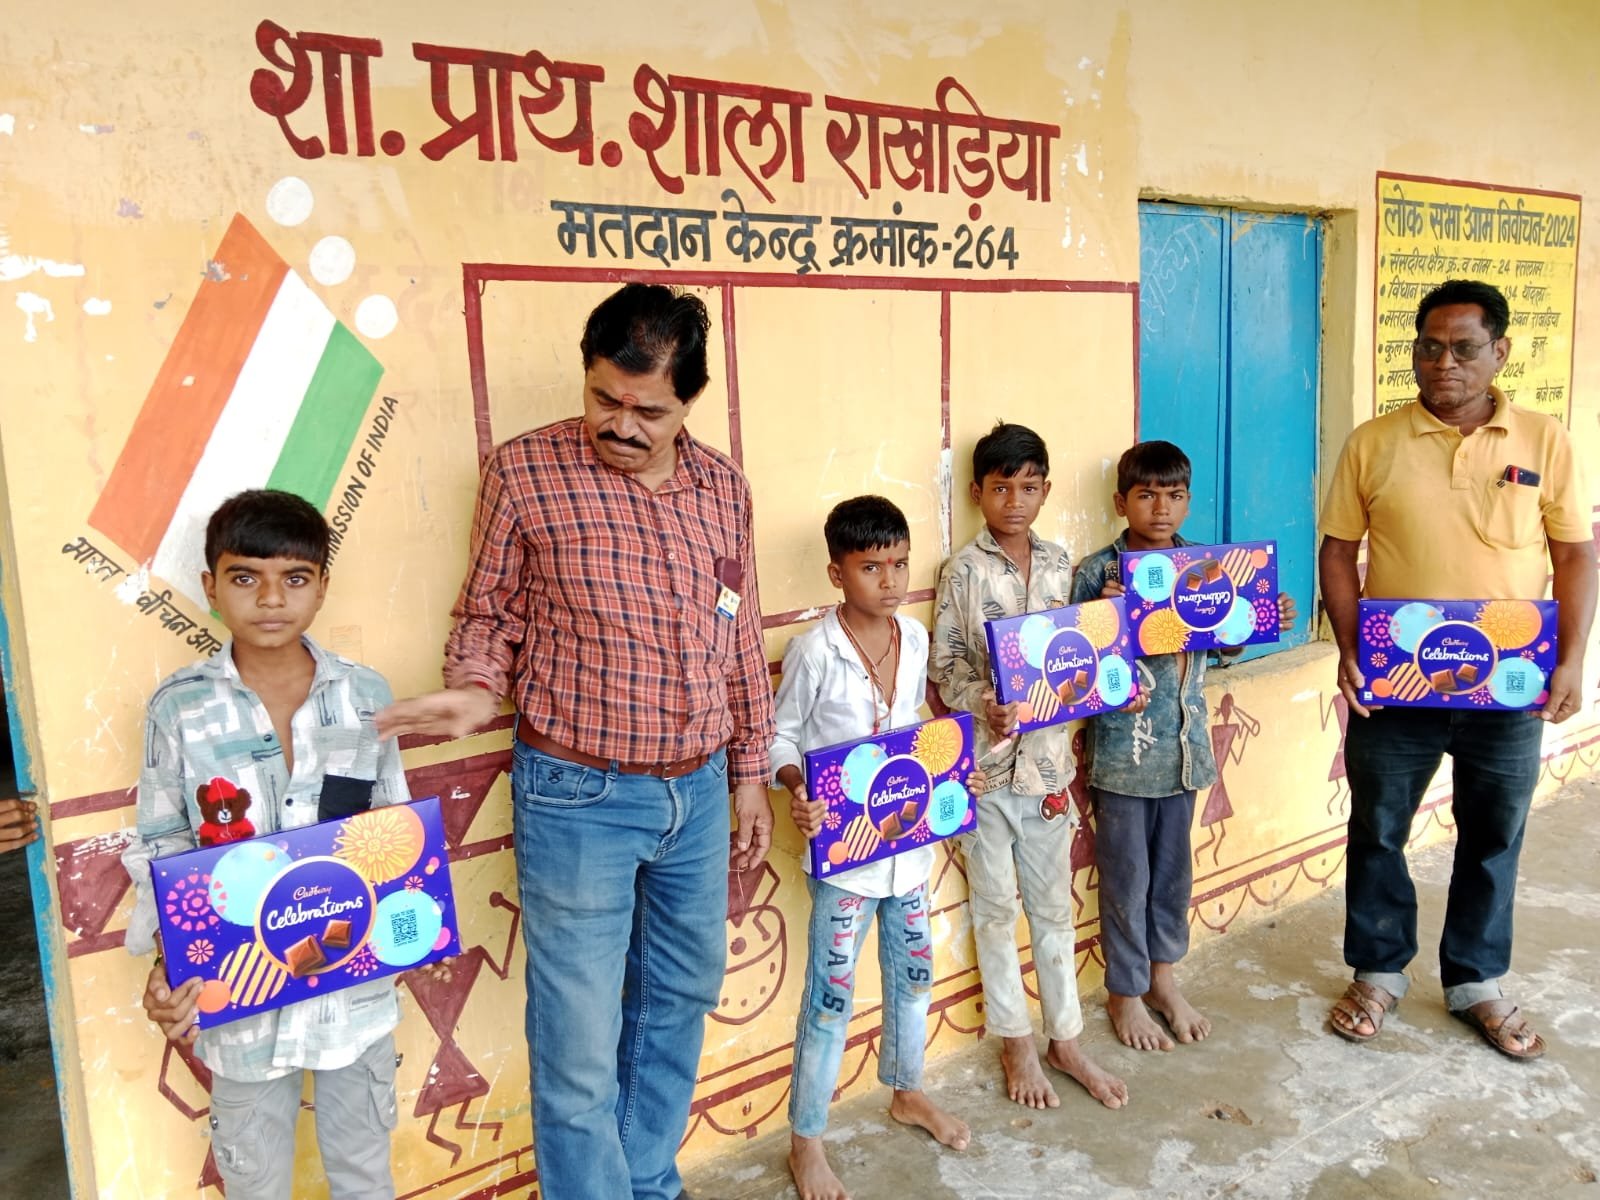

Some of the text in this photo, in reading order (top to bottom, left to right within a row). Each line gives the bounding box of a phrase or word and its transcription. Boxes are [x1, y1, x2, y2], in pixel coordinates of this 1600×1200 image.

[250, 19, 405, 159] शा.
[629, 63, 812, 203] शाला
[551, 200, 717, 267] मतदान
[721, 189, 822, 274] केन्द्र
[1383, 184, 1424, 237] लोक
[1429, 203, 1462, 240] सभा
[1463, 203, 1495, 243] आम
[1502, 361, 1525, 378] 2024
[356, 448, 376, 478] OF
[366, 396, 399, 452] INDIA
[1047, 654, 1093, 673] Celebrations
[1422, 647, 1489, 662] Celebrations
[871, 784, 926, 807] Celebrations
[267, 895, 363, 931] Celebrations
[293, 886, 332, 901] Cadbury
[901, 896, 932, 982] PLAYS
[822, 915, 853, 1013] PLAYS
